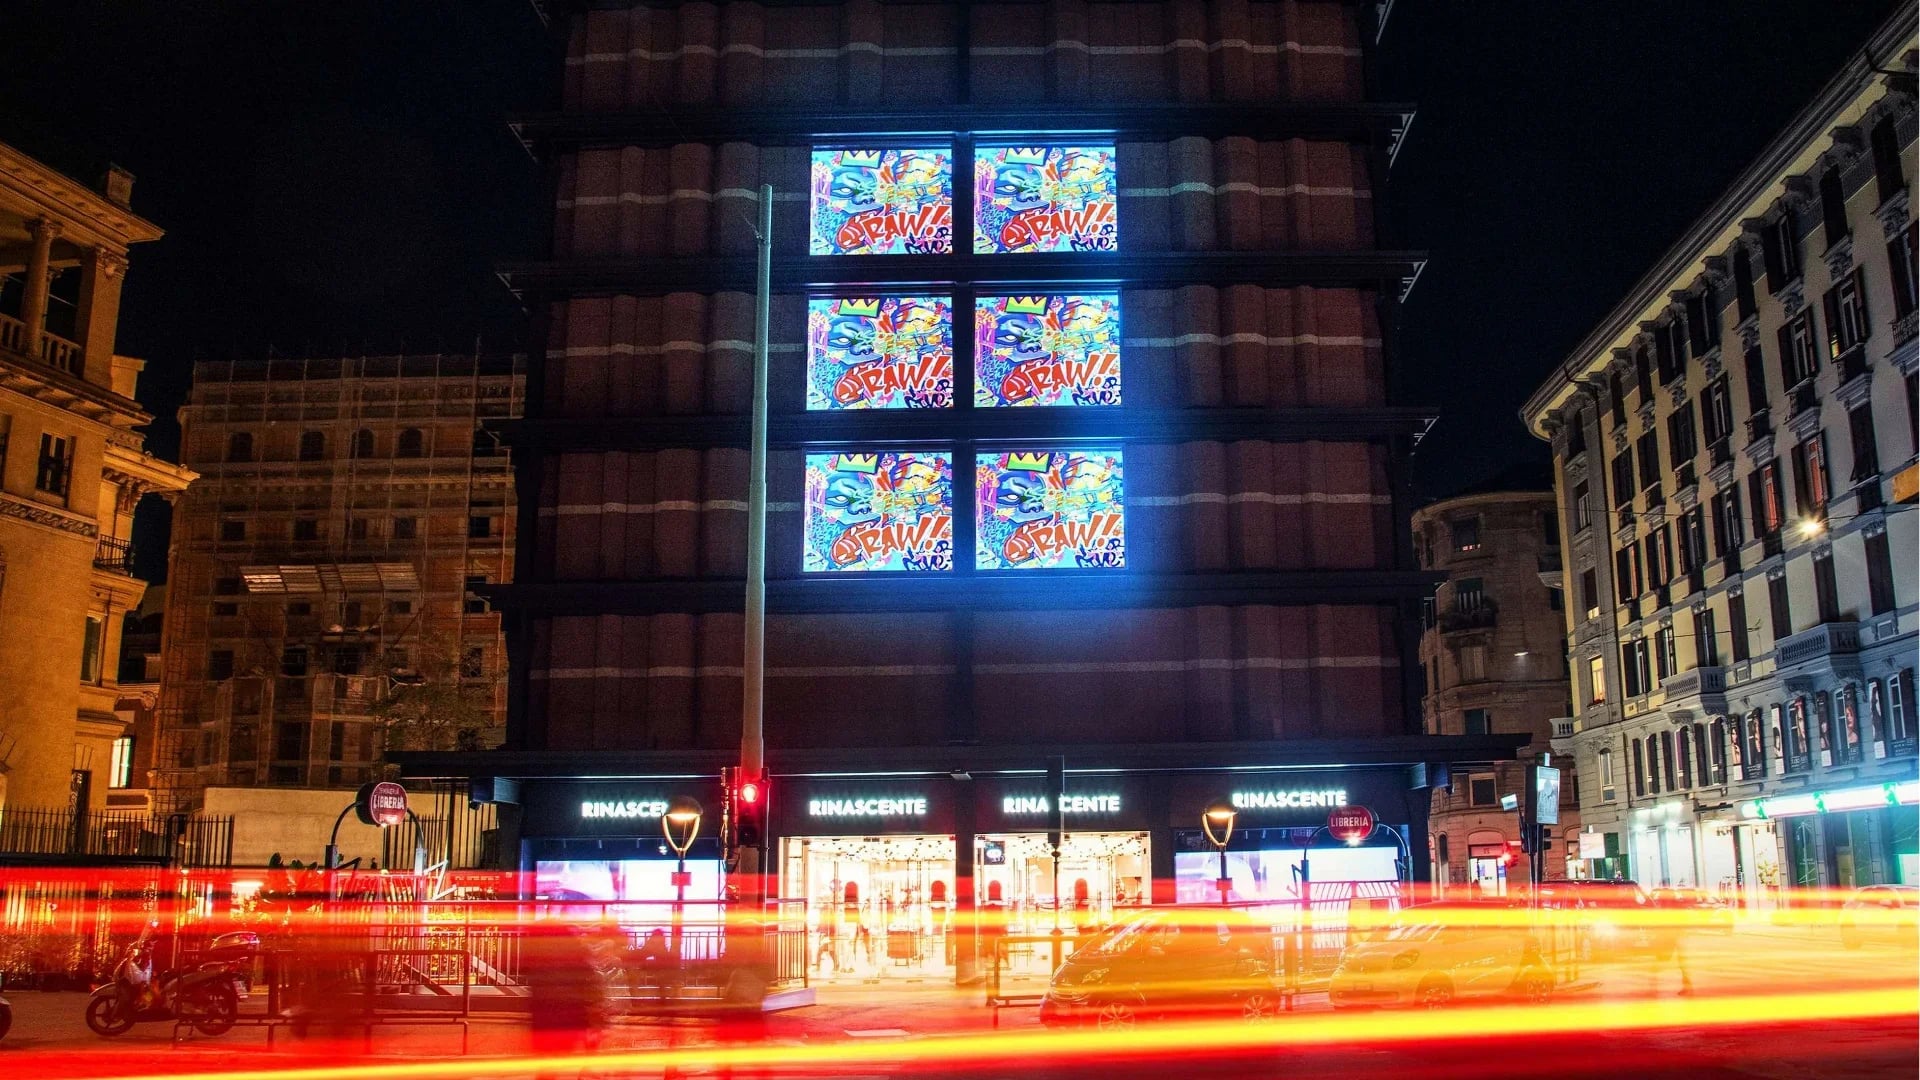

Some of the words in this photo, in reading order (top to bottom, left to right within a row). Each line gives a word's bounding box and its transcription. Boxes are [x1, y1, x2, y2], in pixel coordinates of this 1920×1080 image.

[373, 794, 405, 810] LIBRERIA
[809, 799, 927, 816] RINASCENTE
[1003, 796, 1121, 813] RINACENTE
[1232, 791, 1347, 808] RINASCENTE
[581, 801, 669, 818] RINASCE
[1330, 815, 1370, 828] LIBRERIA
